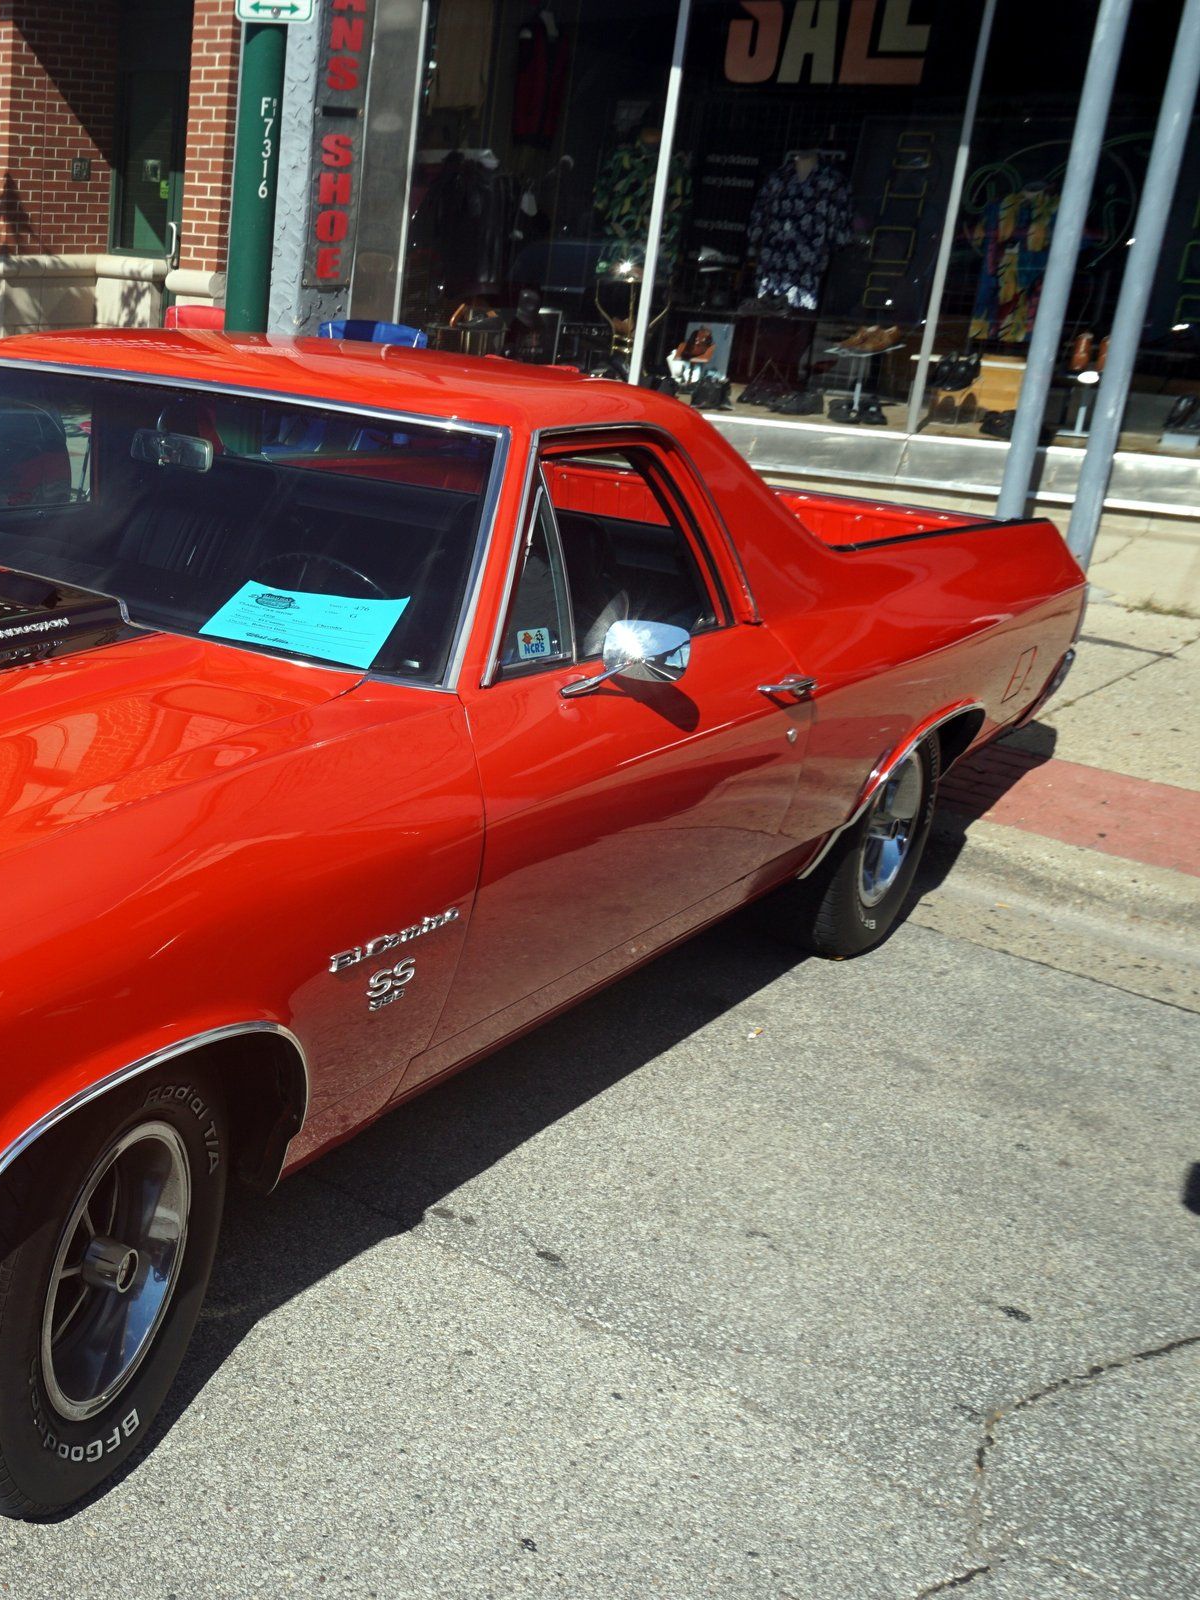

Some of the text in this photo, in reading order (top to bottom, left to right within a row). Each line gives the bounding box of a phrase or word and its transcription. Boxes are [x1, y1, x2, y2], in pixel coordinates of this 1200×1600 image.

[315, 134, 353, 279] SHOE
[524, 642, 546, 654] NCRS
[329, 907, 460, 973] El Camino
[366, 956, 416, 998] SS
[368, 988, 406, 1012] 396
[143, 1084, 209, 1121] Radial
